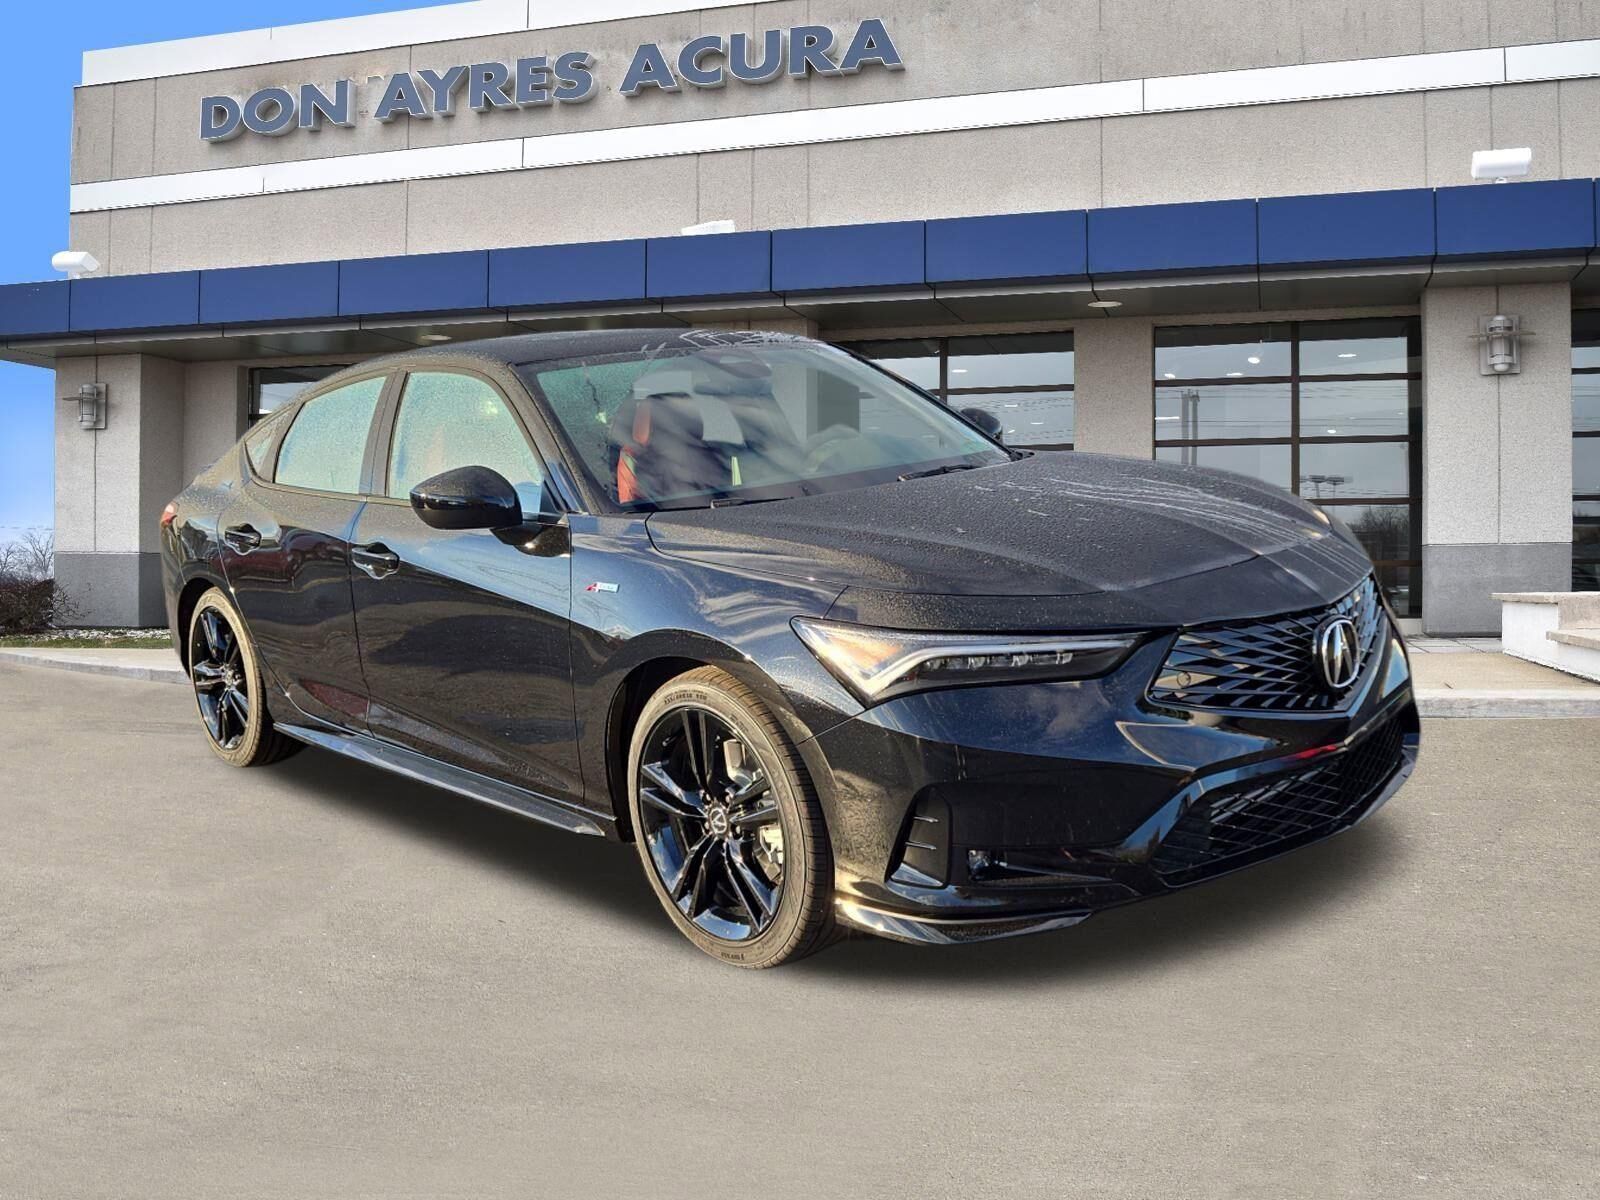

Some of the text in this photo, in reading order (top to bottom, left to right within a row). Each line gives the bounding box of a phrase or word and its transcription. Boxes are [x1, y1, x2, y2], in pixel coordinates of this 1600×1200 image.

[200, 18, 905, 143] DON AYRES ACURA
